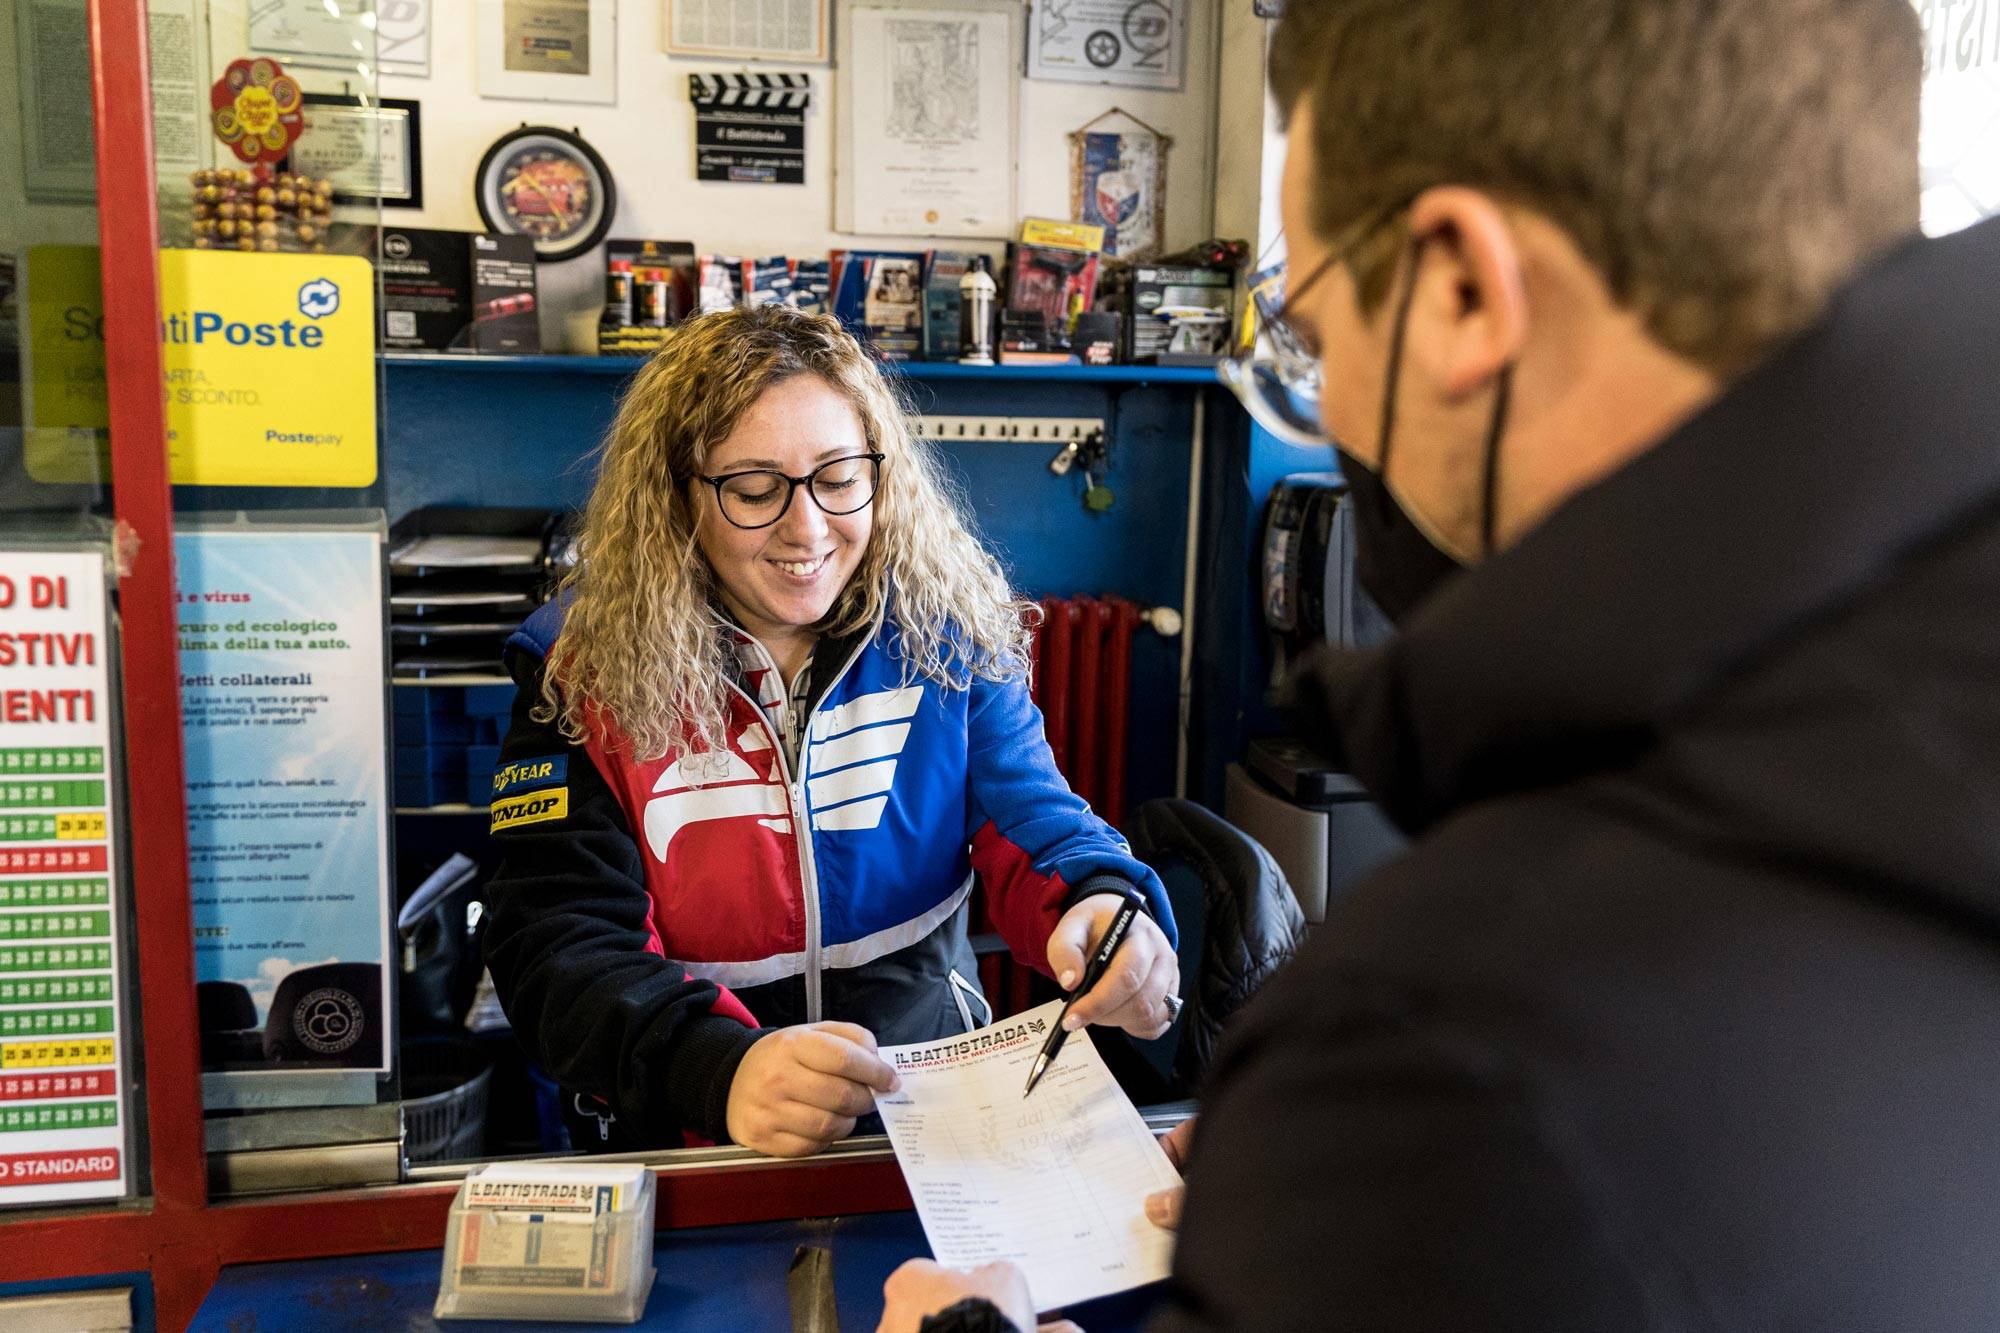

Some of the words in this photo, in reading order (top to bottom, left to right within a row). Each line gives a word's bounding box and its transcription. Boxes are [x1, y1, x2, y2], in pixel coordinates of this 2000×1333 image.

[265, 429, 343, 446] Postepay
[30, 575, 67, 608] DI
[204, 591, 251, 603] virus
[225, 621, 246, 632] ed
[251, 620, 338, 635] ecologico
[225, 638, 269, 650] della
[275, 639, 301, 649] tua
[308, 638, 351, 649] auto.
[220, 673, 313, 687] collaterali
[0, 688, 94, 722] ENTI
[493, 797, 559, 824] UNLOP
[895, 1052, 909, 1064] IL
[911, 1024, 1028, 1063] BATTISTRADA
[897, 1057, 960, 1070] PNEUMATICI
[970, 1036, 1031, 1057] MECCANICA
[13, 1155, 115, 1177] STANDARD
[469, 1183, 481, 1196] IL
[482, 1183, 577, 1198] BATTISTRADA
